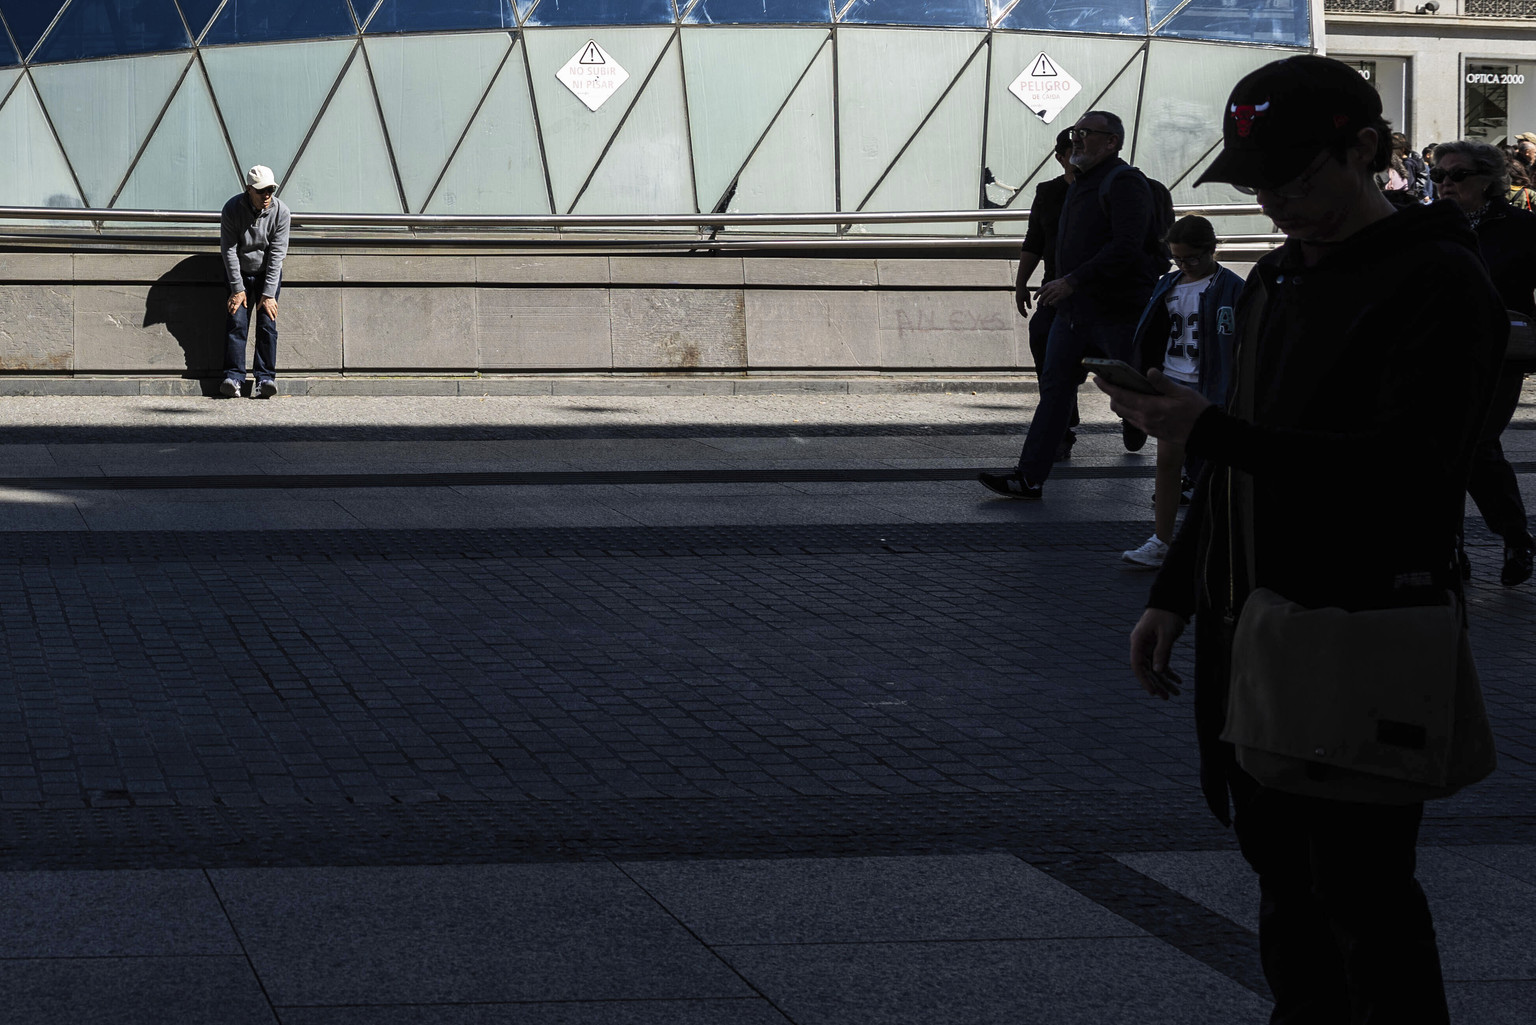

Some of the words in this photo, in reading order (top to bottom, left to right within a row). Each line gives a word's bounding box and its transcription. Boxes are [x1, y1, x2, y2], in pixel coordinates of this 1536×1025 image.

[569, 66, 584, 75] NO
[587, 66, 616, 75] SUBIR
[1466, 73, 1500, 84] OPTICA
[1501, 74, 1525, 84] 2000
[572, 80, 582, 89] NI
[586, 80, 614, 89] PISAR
[1020, 80, 1071, 92] PELIGRO
